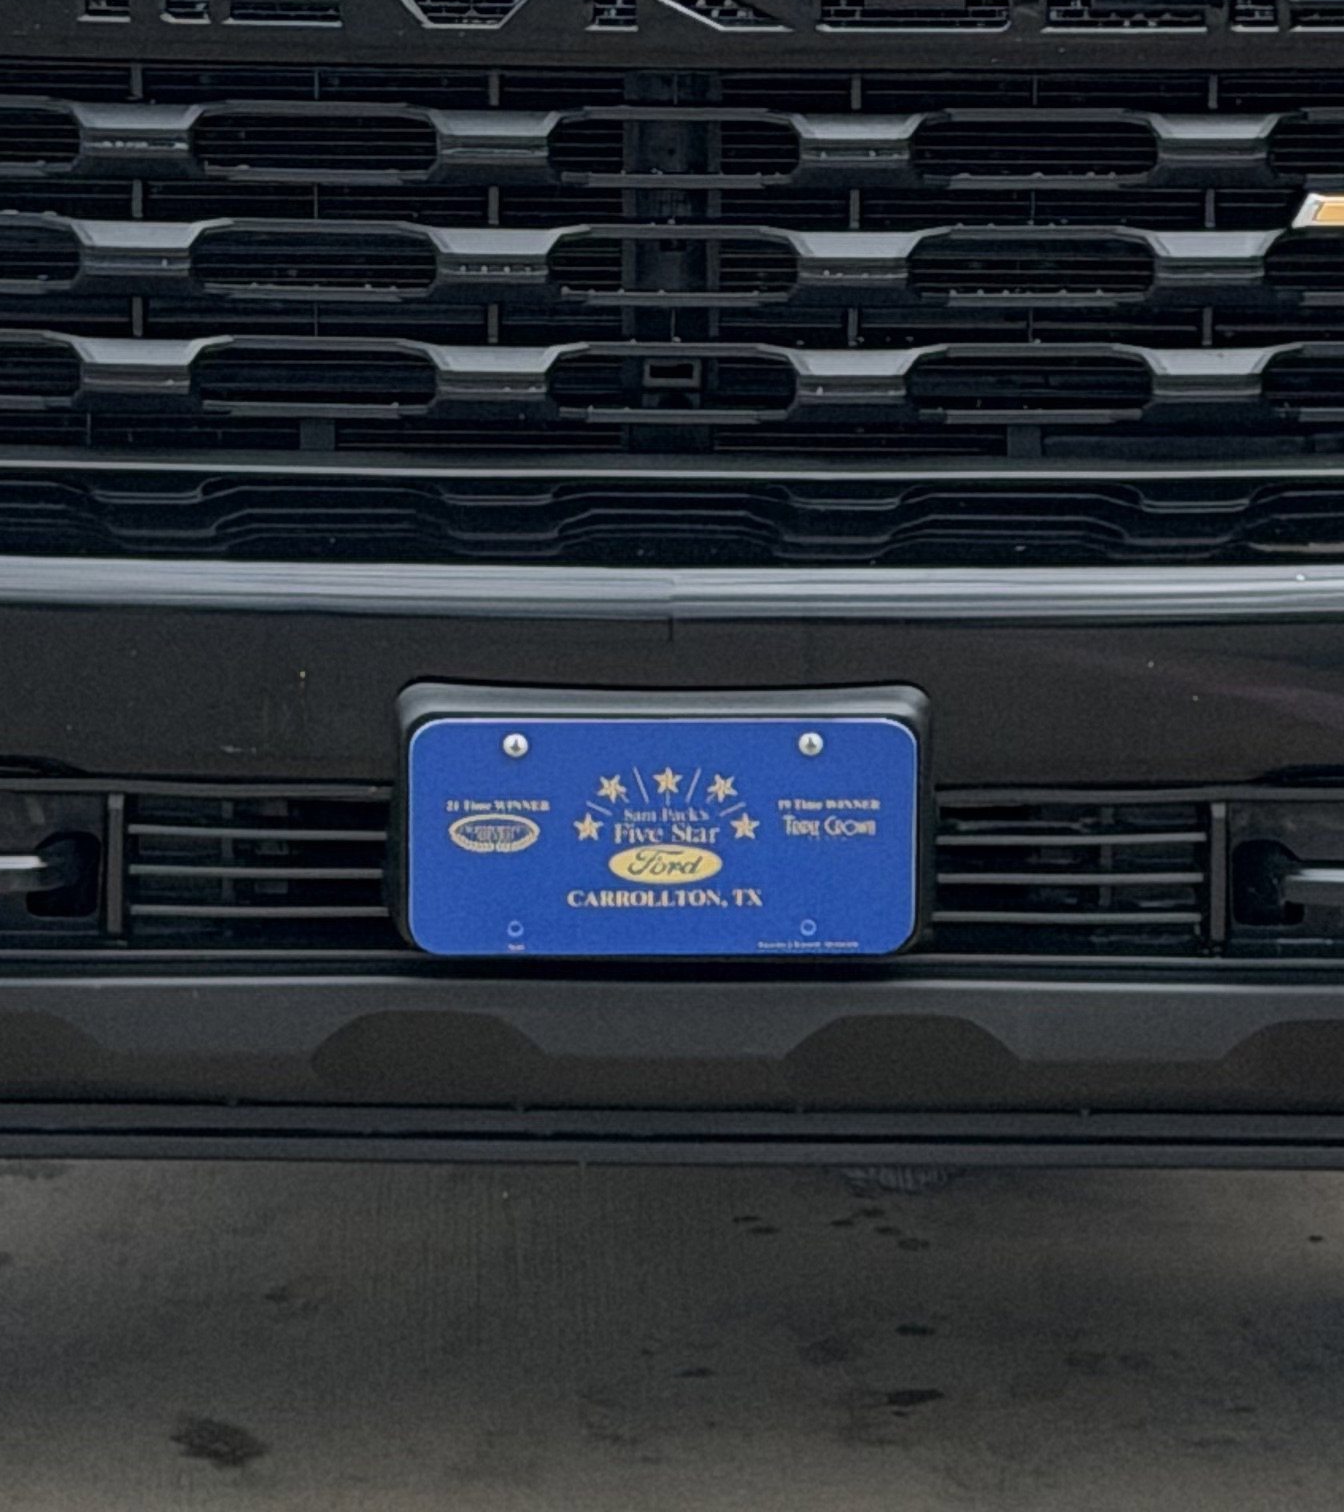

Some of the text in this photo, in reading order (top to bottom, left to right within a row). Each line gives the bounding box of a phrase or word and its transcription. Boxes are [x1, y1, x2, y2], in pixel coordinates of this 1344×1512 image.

[613, 821, 720, 844] Five Star
[627, 848, 704, 876] Ford
[566, 889, 763, 908] CARROLLTON, TX
